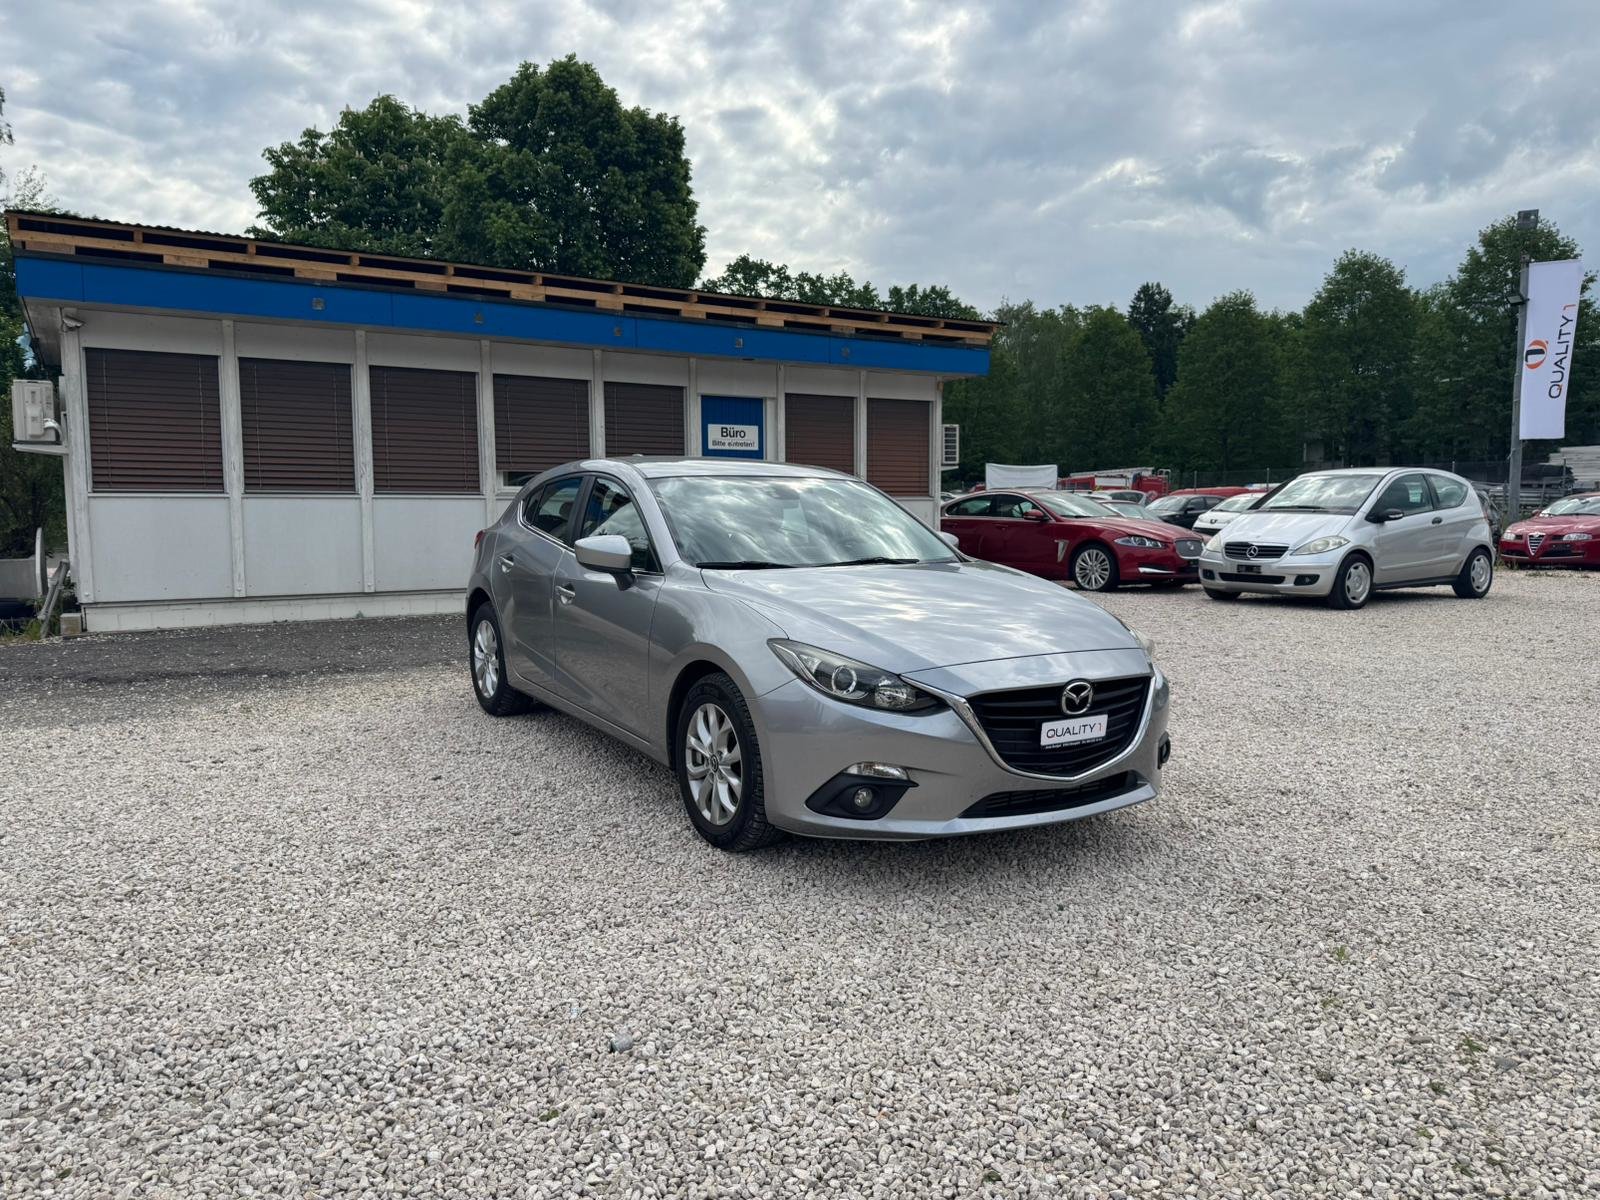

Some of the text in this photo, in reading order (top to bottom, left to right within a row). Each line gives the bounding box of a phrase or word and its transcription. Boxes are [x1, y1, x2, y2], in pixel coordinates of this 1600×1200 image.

[1548, 315, 1573, 399] QUALITY
[720, 426, 746, 439] Büro
[1046, 722, 1096, 739] QUALITY
